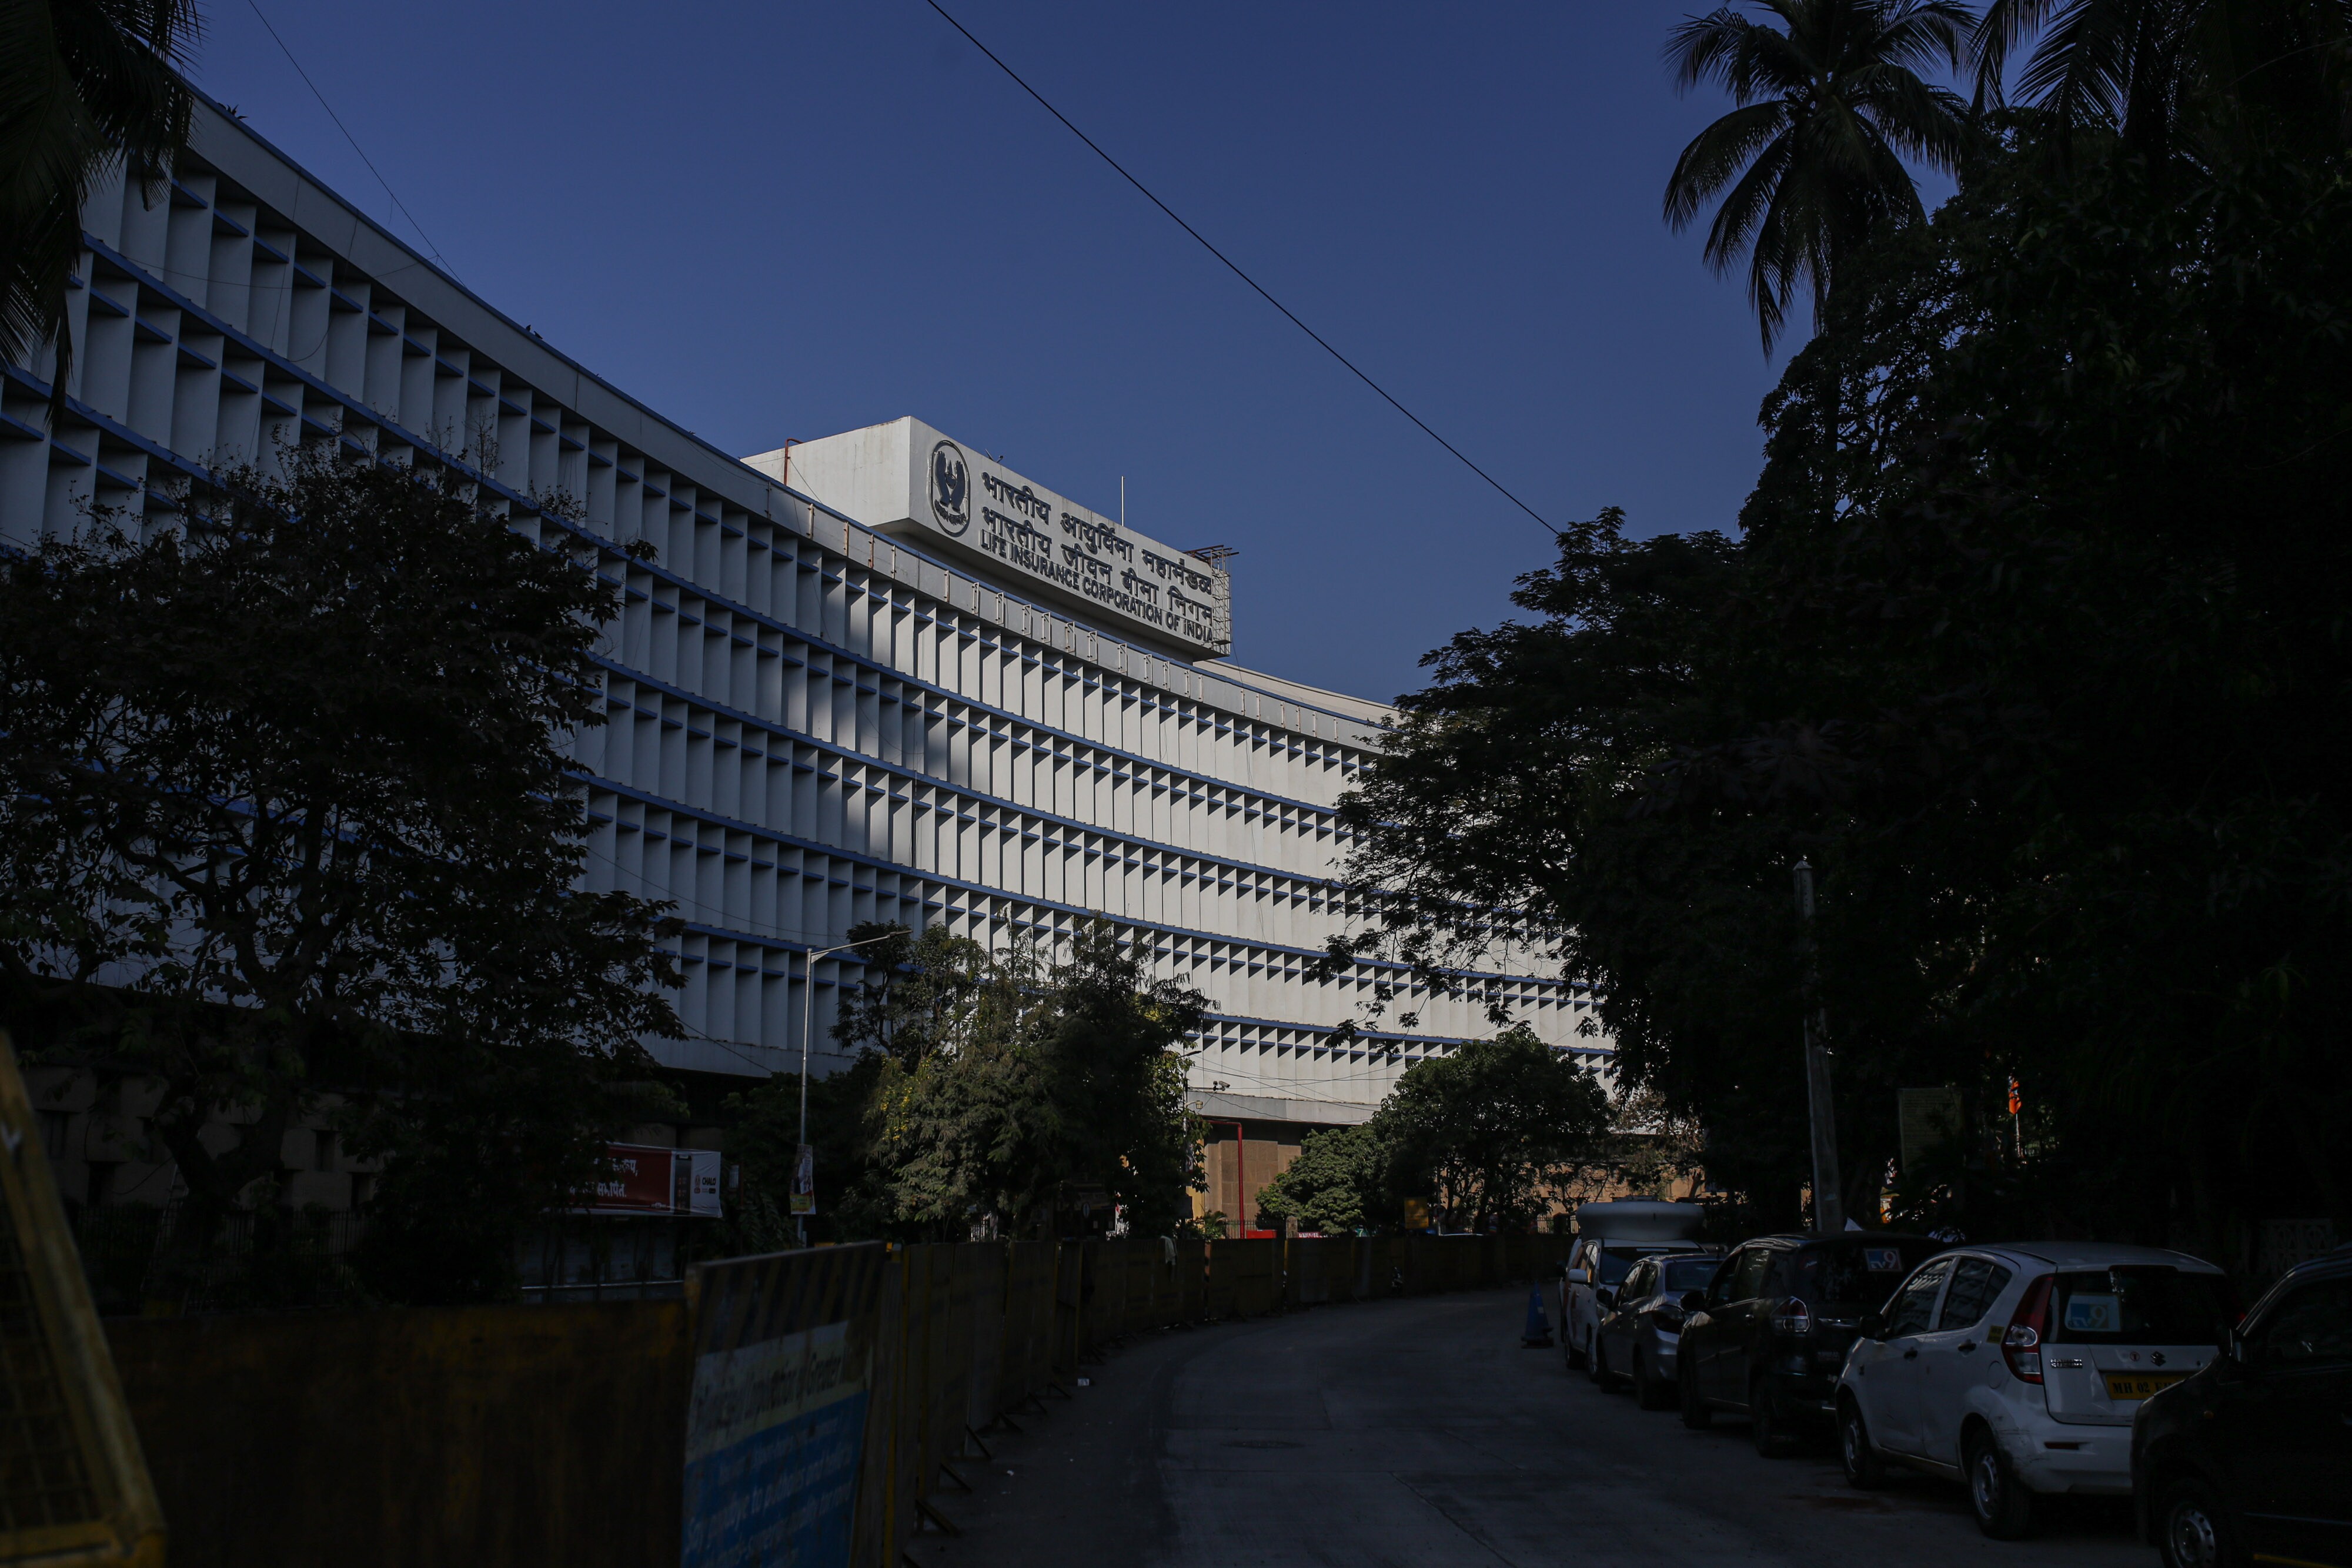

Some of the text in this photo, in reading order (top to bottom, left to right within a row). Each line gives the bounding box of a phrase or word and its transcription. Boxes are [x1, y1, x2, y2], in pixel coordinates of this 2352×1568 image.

[981, 472, 1051, 525] भारतीय
[1060, 513, 1134, 563] आयुर्विमा
[1141, 549, 1212, 595] महामंडळ
[981, 506, 1052, 559] भारतीय
[1060, 543, 1113, 586] जीवन
[1120, 567, 1160, 605] बीमा
[1167, 586, 1212, 627] निगम
[980, 529, 1213, 641] LIFE INSURANCE CORPORATION OF INDIA
[702, 1177, 716, 1186] CHALO
[2072, 1305, 2108, 1328] TV9
[2112, 1383, 2133, 1393] MH
[2137, 1382, 2150, 1393] 02
